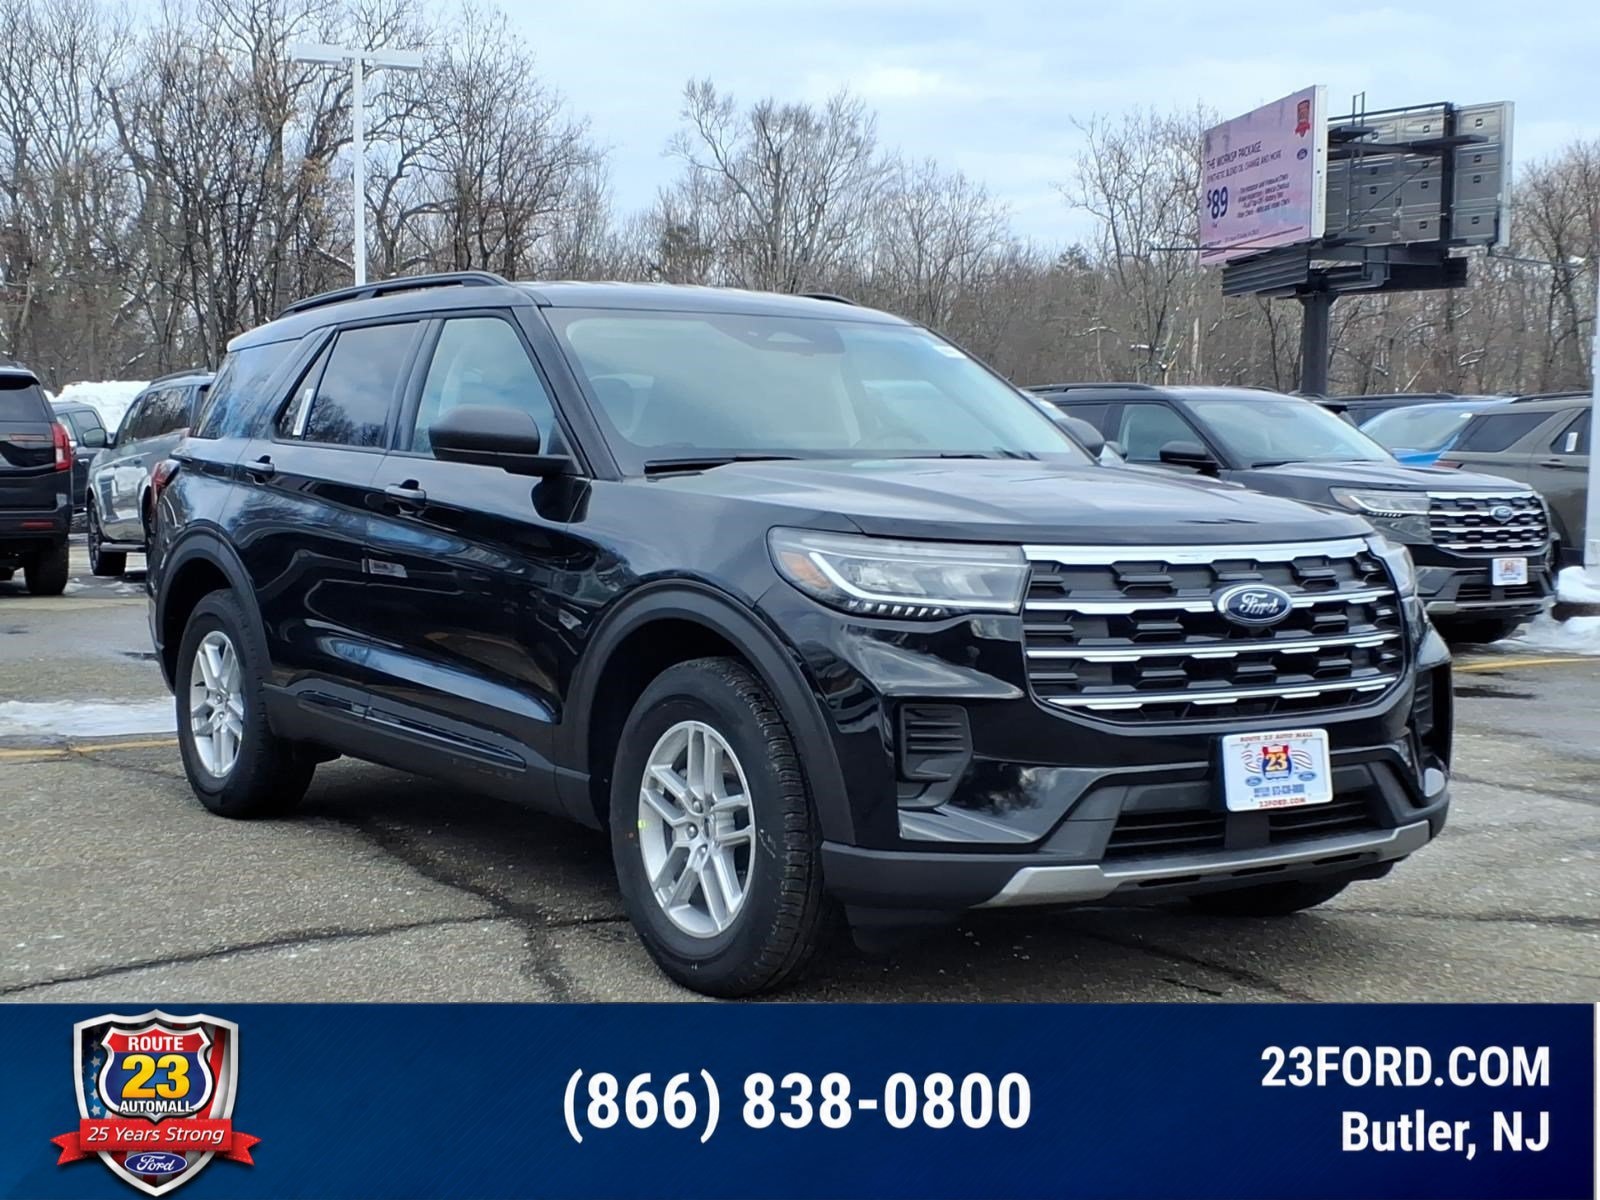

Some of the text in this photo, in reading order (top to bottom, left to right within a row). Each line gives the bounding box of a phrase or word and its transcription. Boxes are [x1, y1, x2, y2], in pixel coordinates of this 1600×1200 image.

[1206, 186, 1229, 219] $89
[1239, 592, 1280, 616] Ford
[1265, 752, 1288, 771] 23
